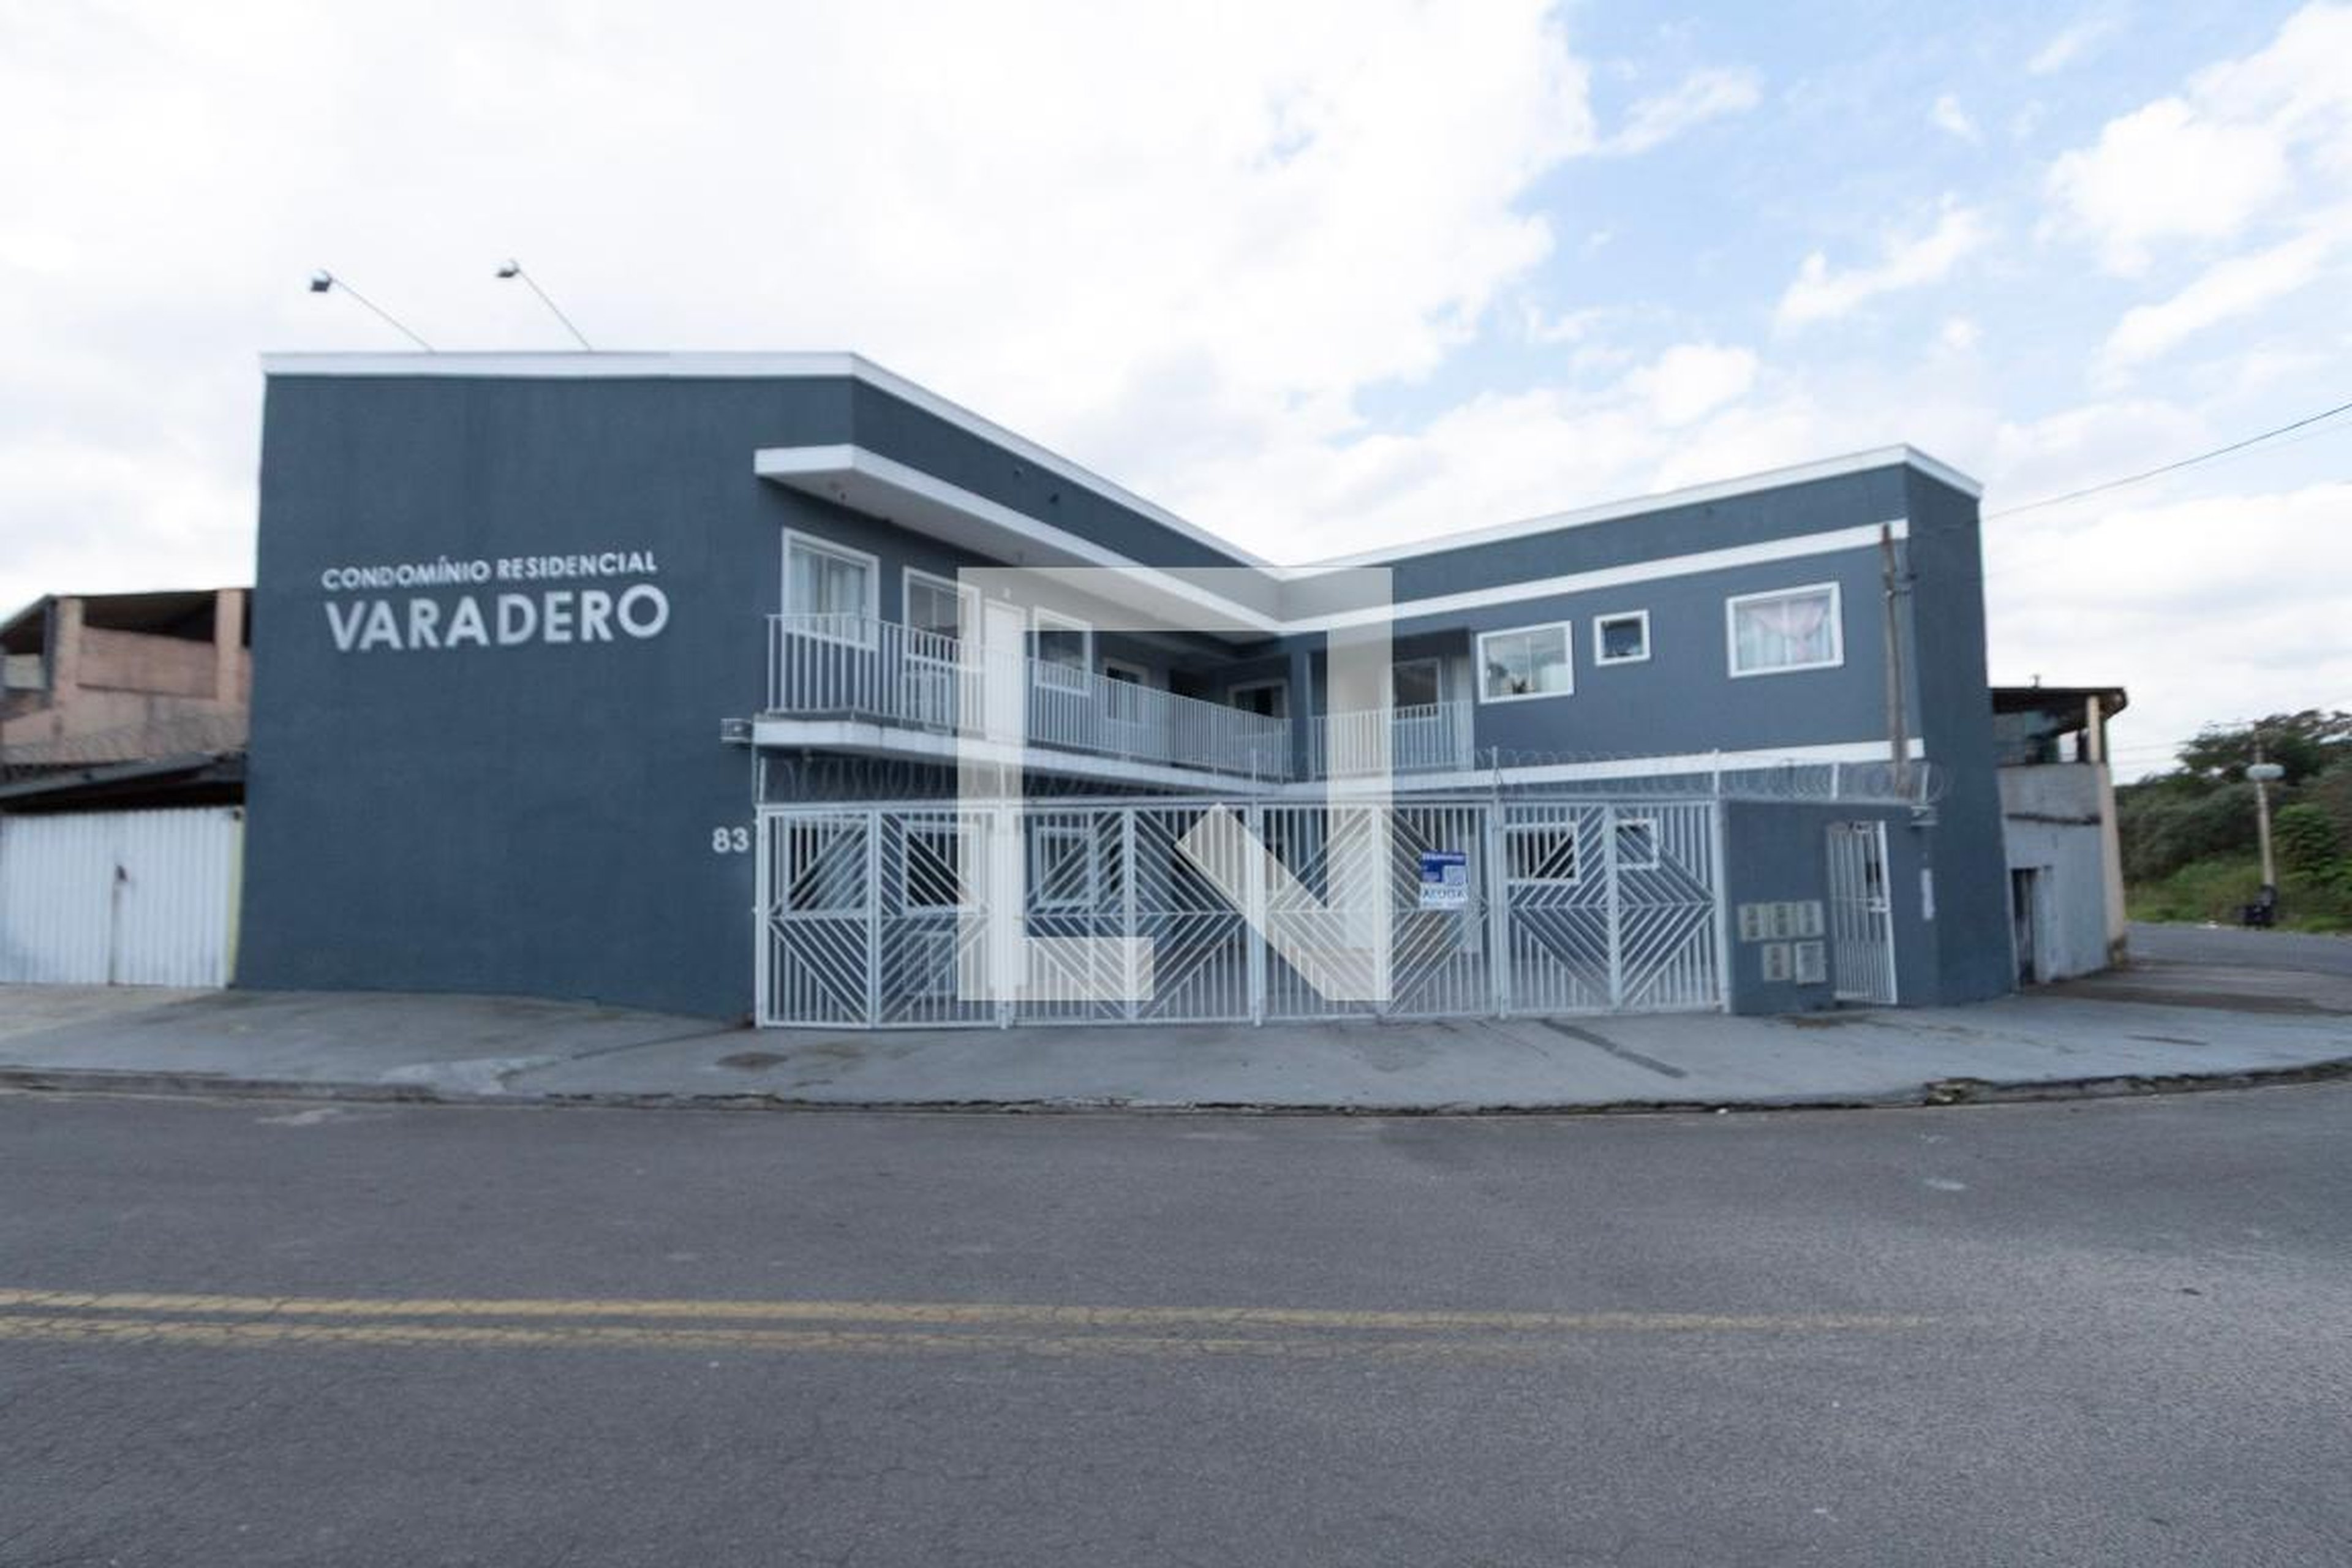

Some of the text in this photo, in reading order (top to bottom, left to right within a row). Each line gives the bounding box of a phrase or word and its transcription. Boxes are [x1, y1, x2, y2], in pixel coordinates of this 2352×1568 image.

[322, 551, 658, 590] CONDOMÍNIO RESIDENCIAL
[325, 584, 669, 651] VARADERO
[712, 827, 748, 853] 83
